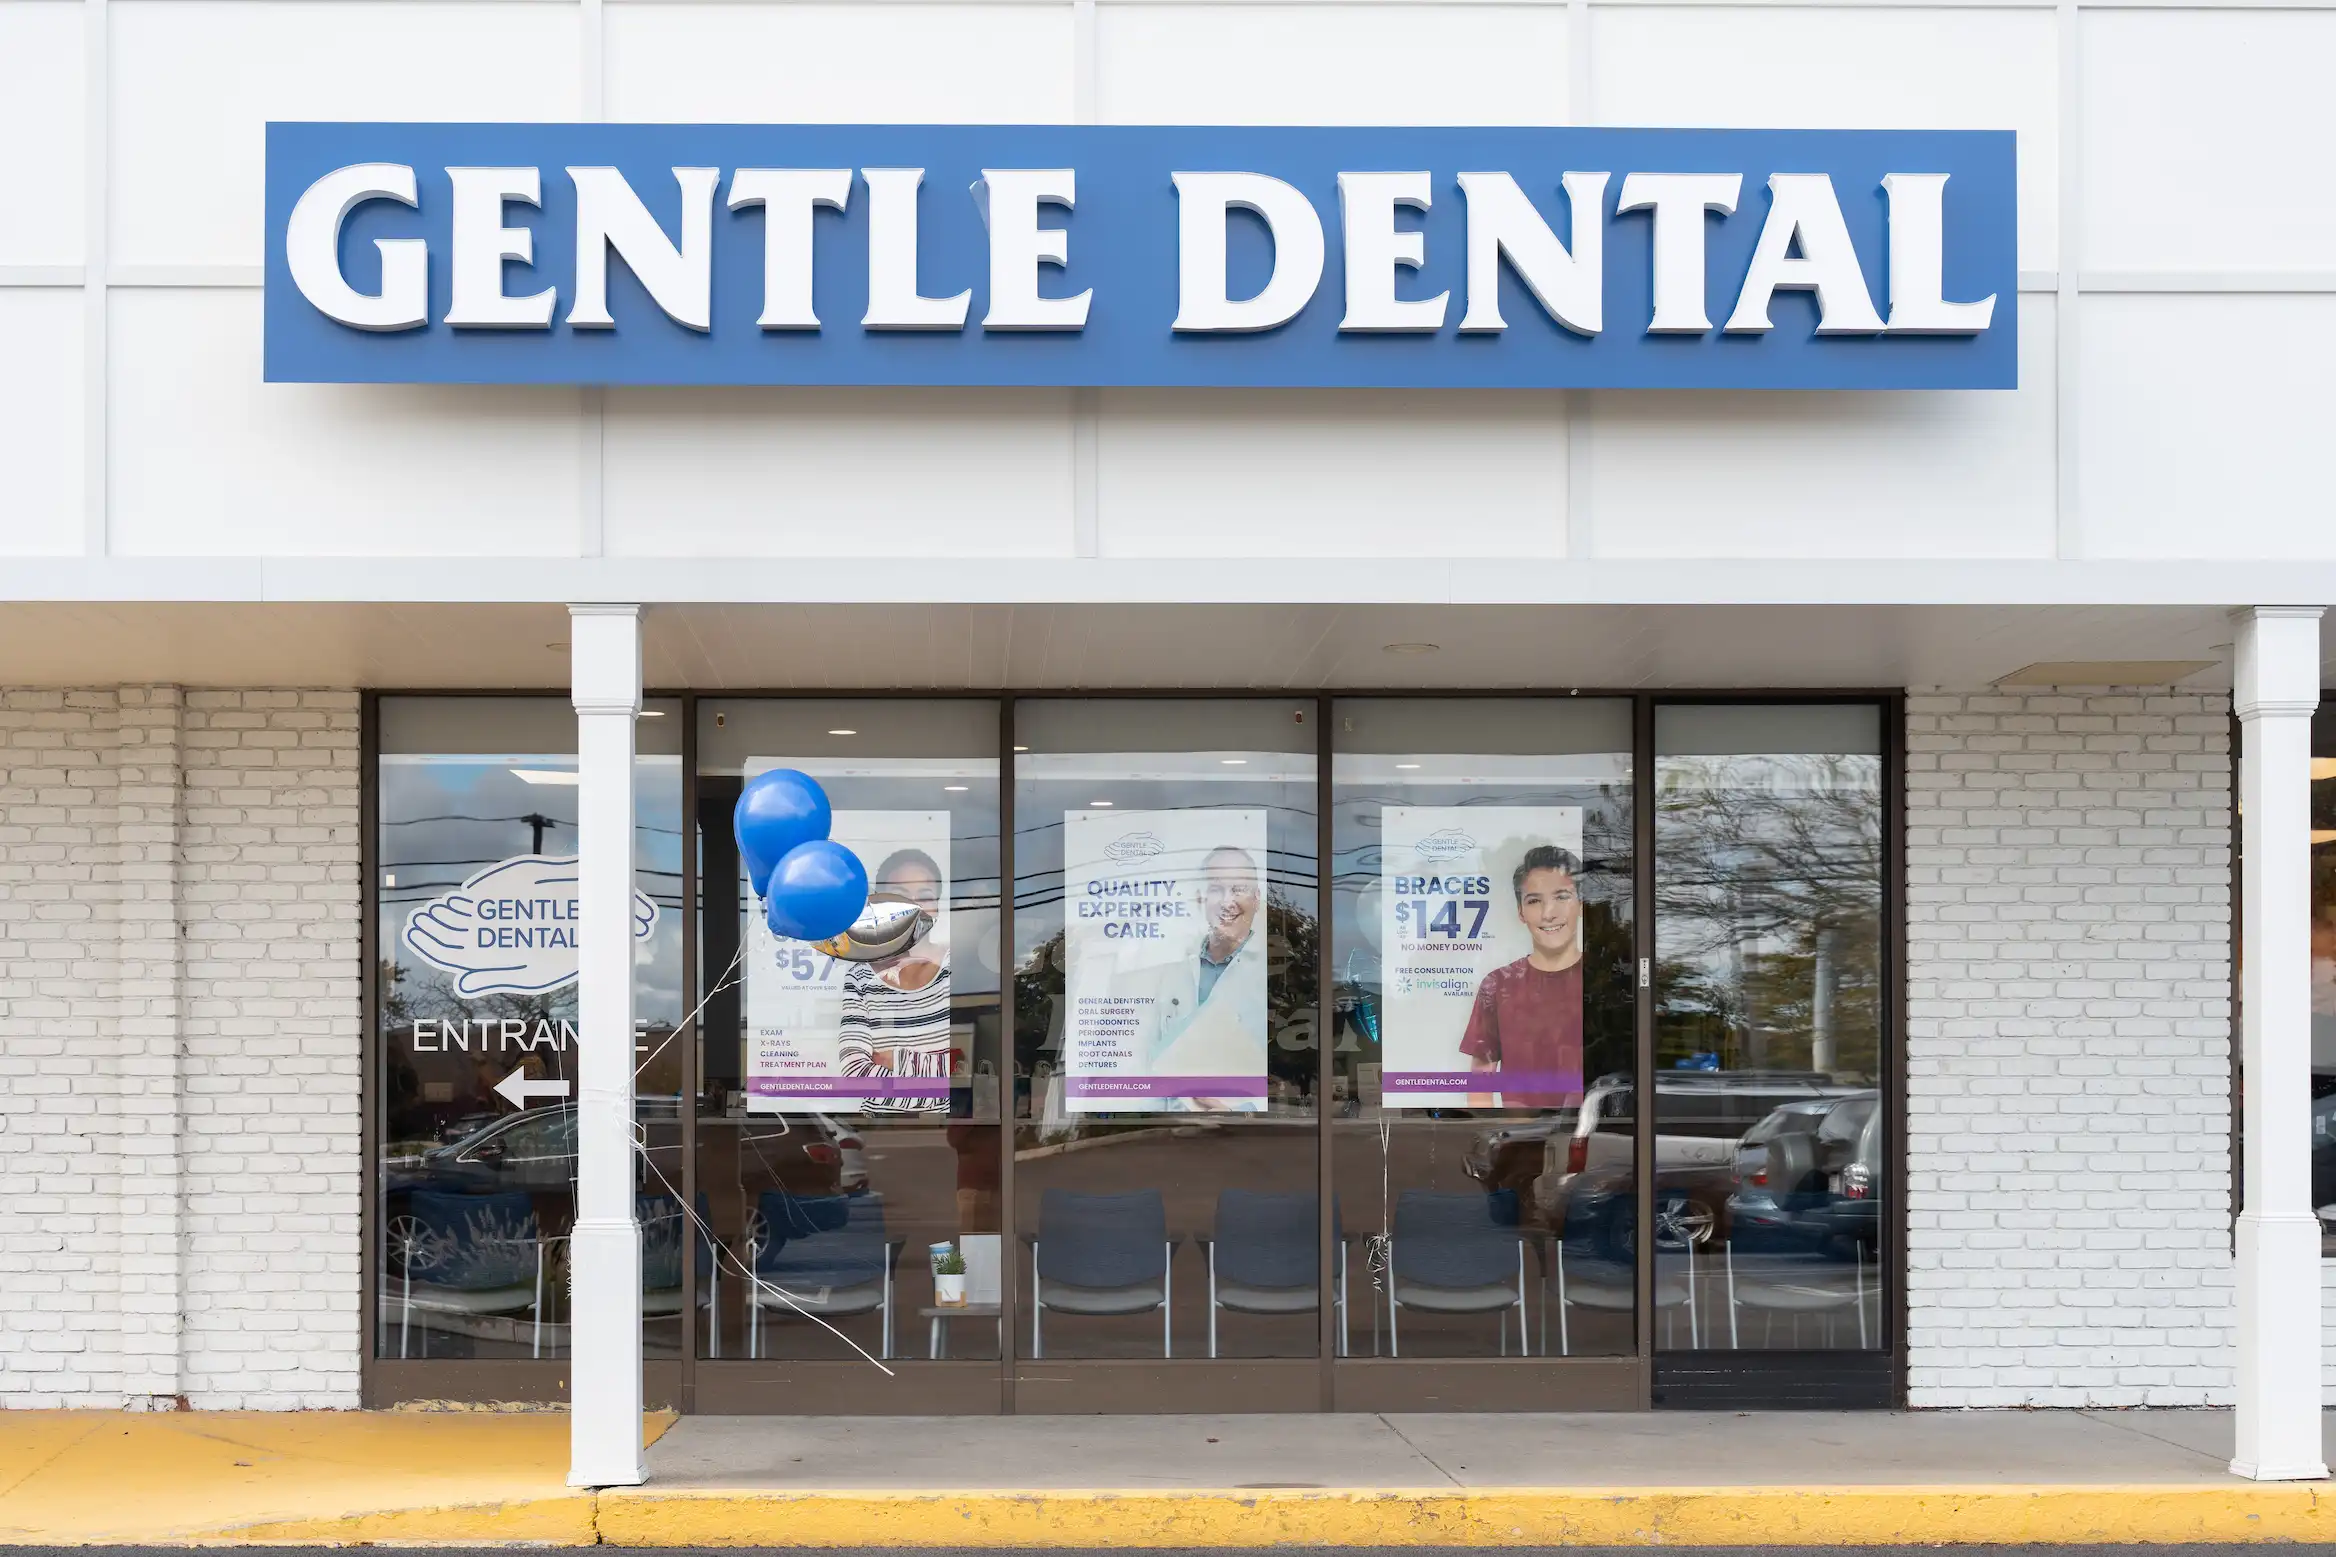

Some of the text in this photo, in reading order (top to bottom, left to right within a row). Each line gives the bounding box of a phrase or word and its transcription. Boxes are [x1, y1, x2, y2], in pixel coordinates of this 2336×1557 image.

[286, 162, 1997, 337] GENTLE DENTAL
[1087, 880, 1181, 899] QUALITY.
[1395, 876, 1490, 895] BRACES
[477, 899, 579, 920] GENTLE
[1078, 901, 1191, 918] EXPERTISE.
[1395, 900, 1490, 939] $147
[478, 928, 579, 948] DENTAL
[1103, 922, 1165, 938] CARE.
[1401, 943, 1483, 951] NO MONEY DOWN
[1416, 978, 1469, 991] invisalign
[1078, 997, 1155, 1005] GENERAL DENTISTRY
[413, 1018, 649, 1052] ENTRANE
[1078, 1029, 1135, 1037] PERIODONTICS
[1395, 1078, 1468, 1086] GENTLEDENTAL.COM
